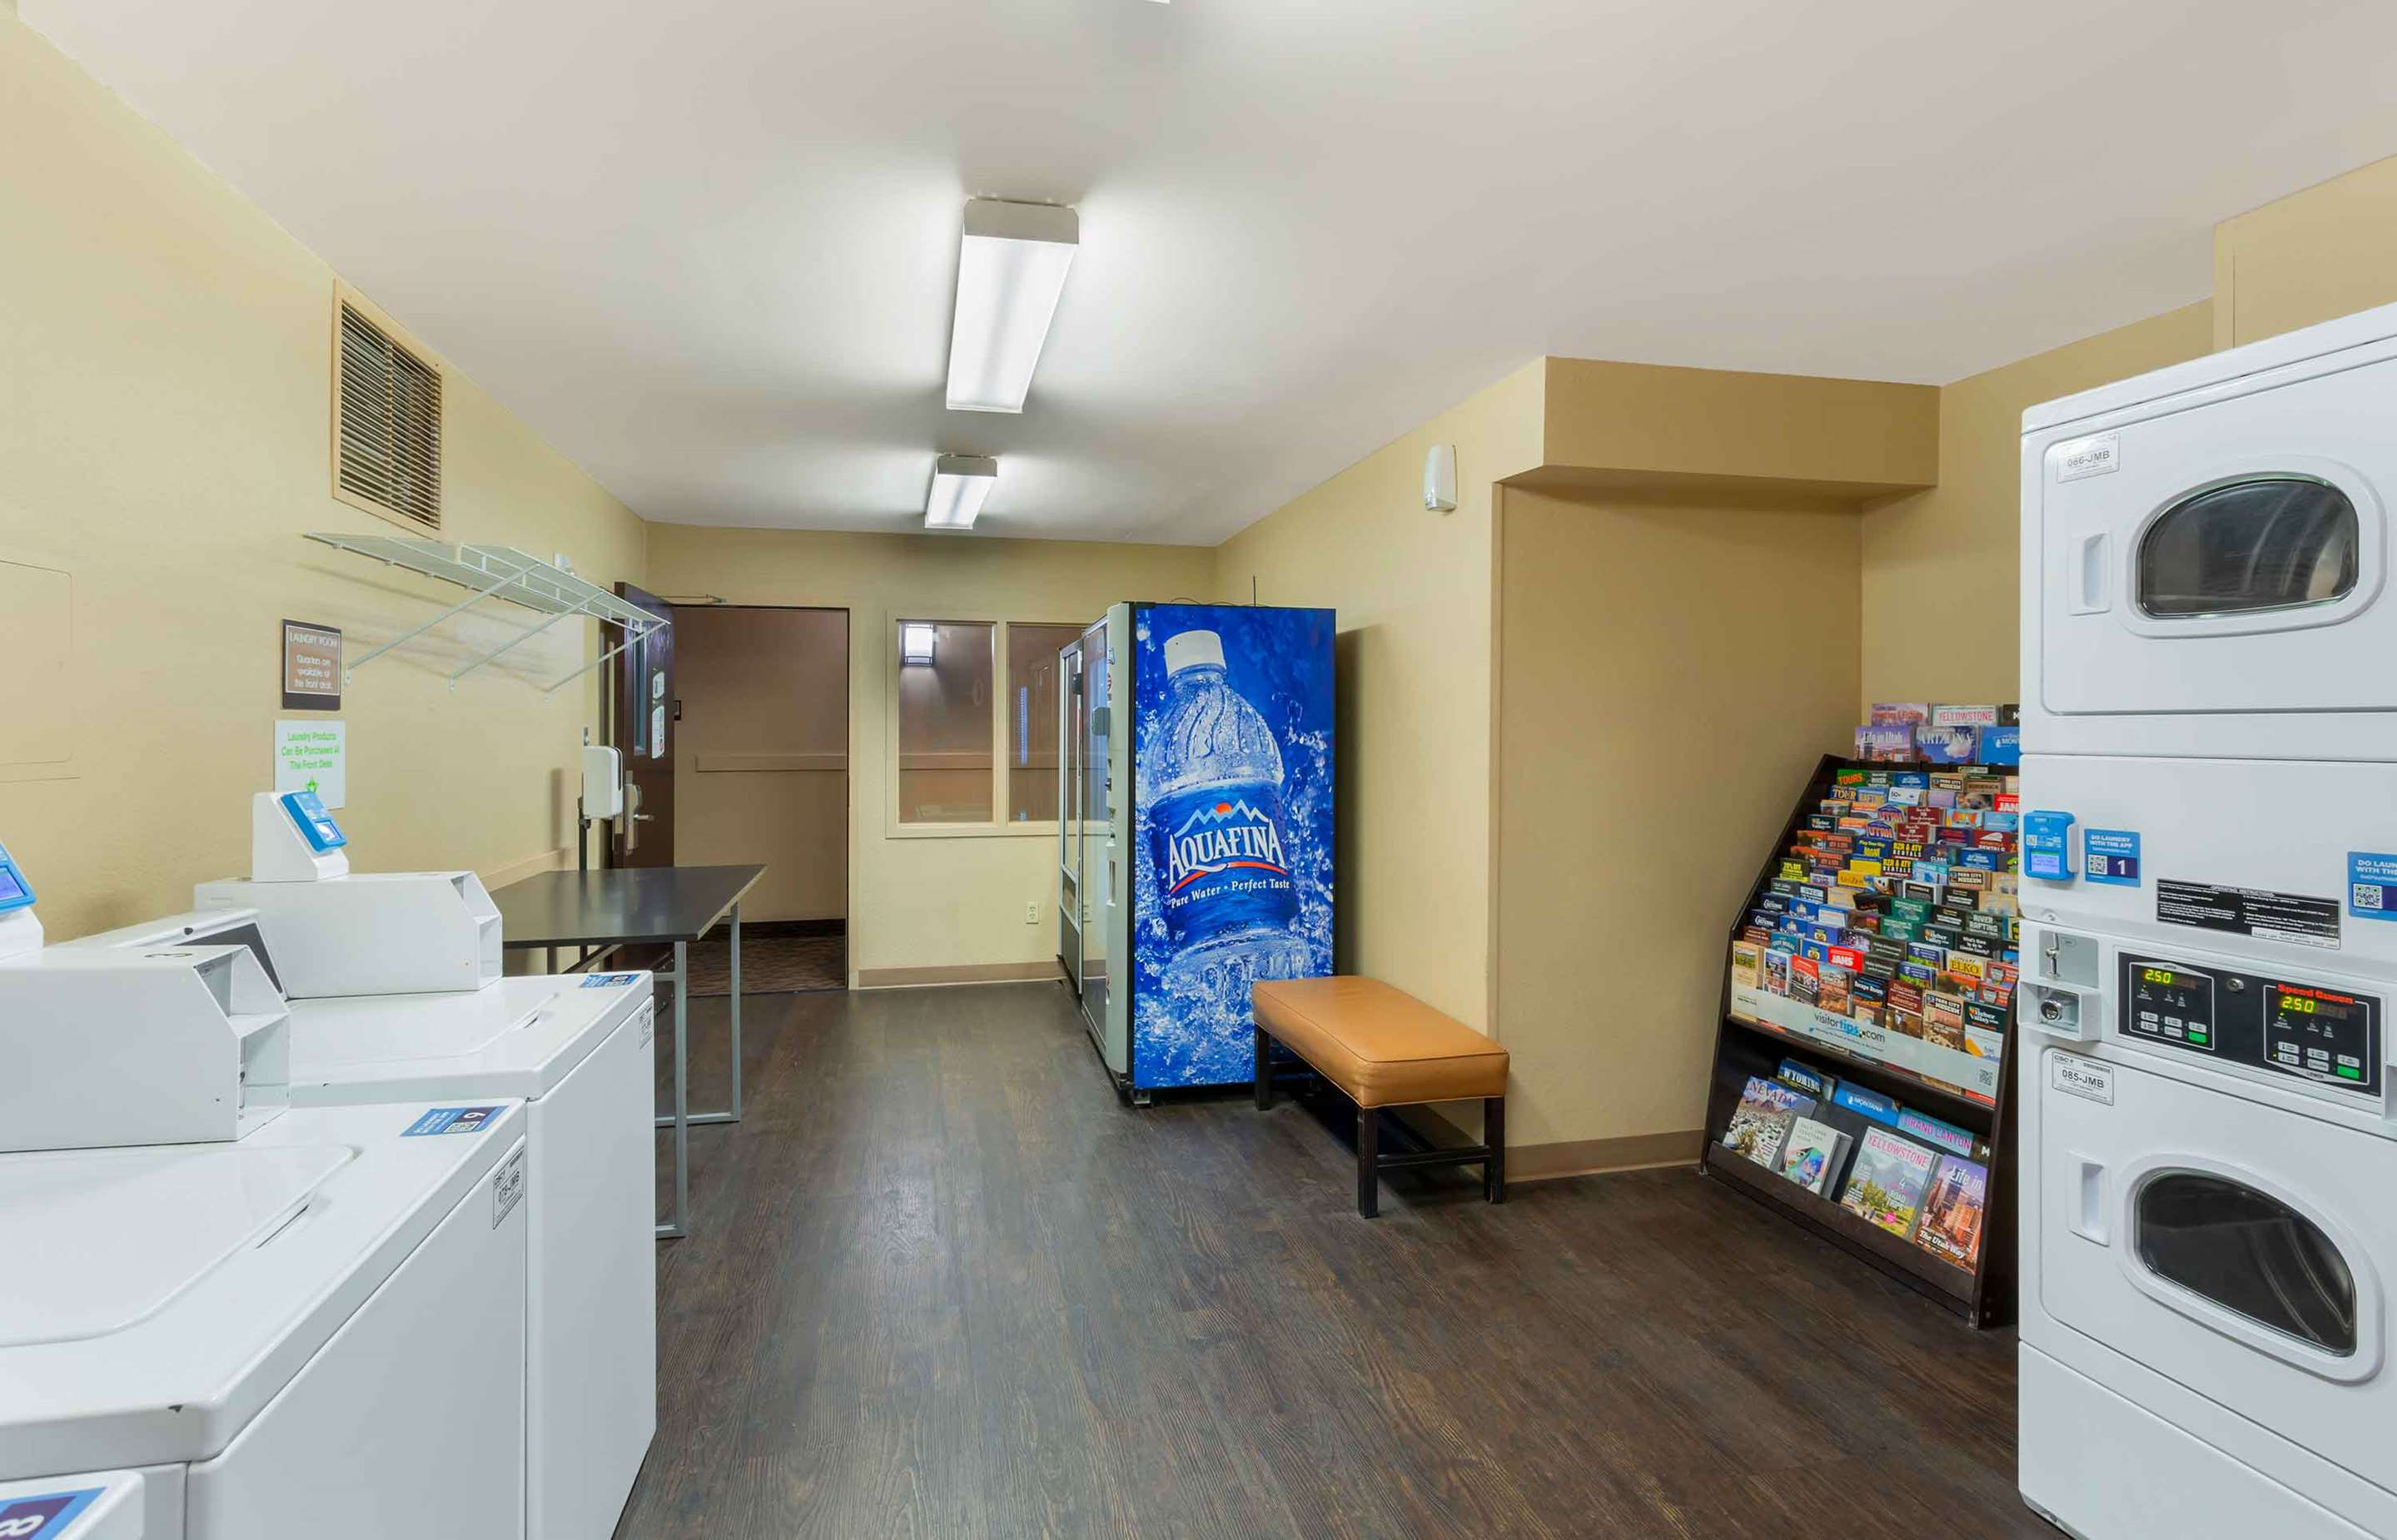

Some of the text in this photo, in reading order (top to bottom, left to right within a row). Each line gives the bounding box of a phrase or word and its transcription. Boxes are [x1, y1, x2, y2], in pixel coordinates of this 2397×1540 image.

[1939, 710, 1993, 722] YELLOWSTONE
[1838, 772, 1863, 786] TOURS
[1168, 818, 1287, 891] AQUAFINA
[2117, 860, 2126, 875] 1
[2355, 866, 2380, 874] WITH
[1171, 878, 1291, 909] Pure Water Perfect Taste
[1969, 921, 1998, 932] RAFTING
[1973, 914, 1993, 923] RIVER
[1951, 960, 1979, 975] ELKO
[2145, 969, 2171, 984] 2.50
[2277, 983, 2355, 1005] Speed Queen
[1935, 1002, 1961, 1016] MUSEUM
[1948, 1001, 1961, 1009] CITY
[2281, 996, 2315, 1013] 2.50
[1814, 1012, 1886, 1043] visitortips.com
[2061, 1069, 2105, 1088] 085-JMB
[1749, 1080, 1793, 1107] NEVADA
[1853, 1096, 1883, 1113] MONTANA
[1934, 1126, 1972, 1150] CANYON
[1867, 1131, 1928, 1167] YELLOWSTONE
[1898, 1177, 1906, 1190] 4
[1949, 1165, 1983, 1191] Life in
[1918, 1230, 1967, 1259] The Utah Way
